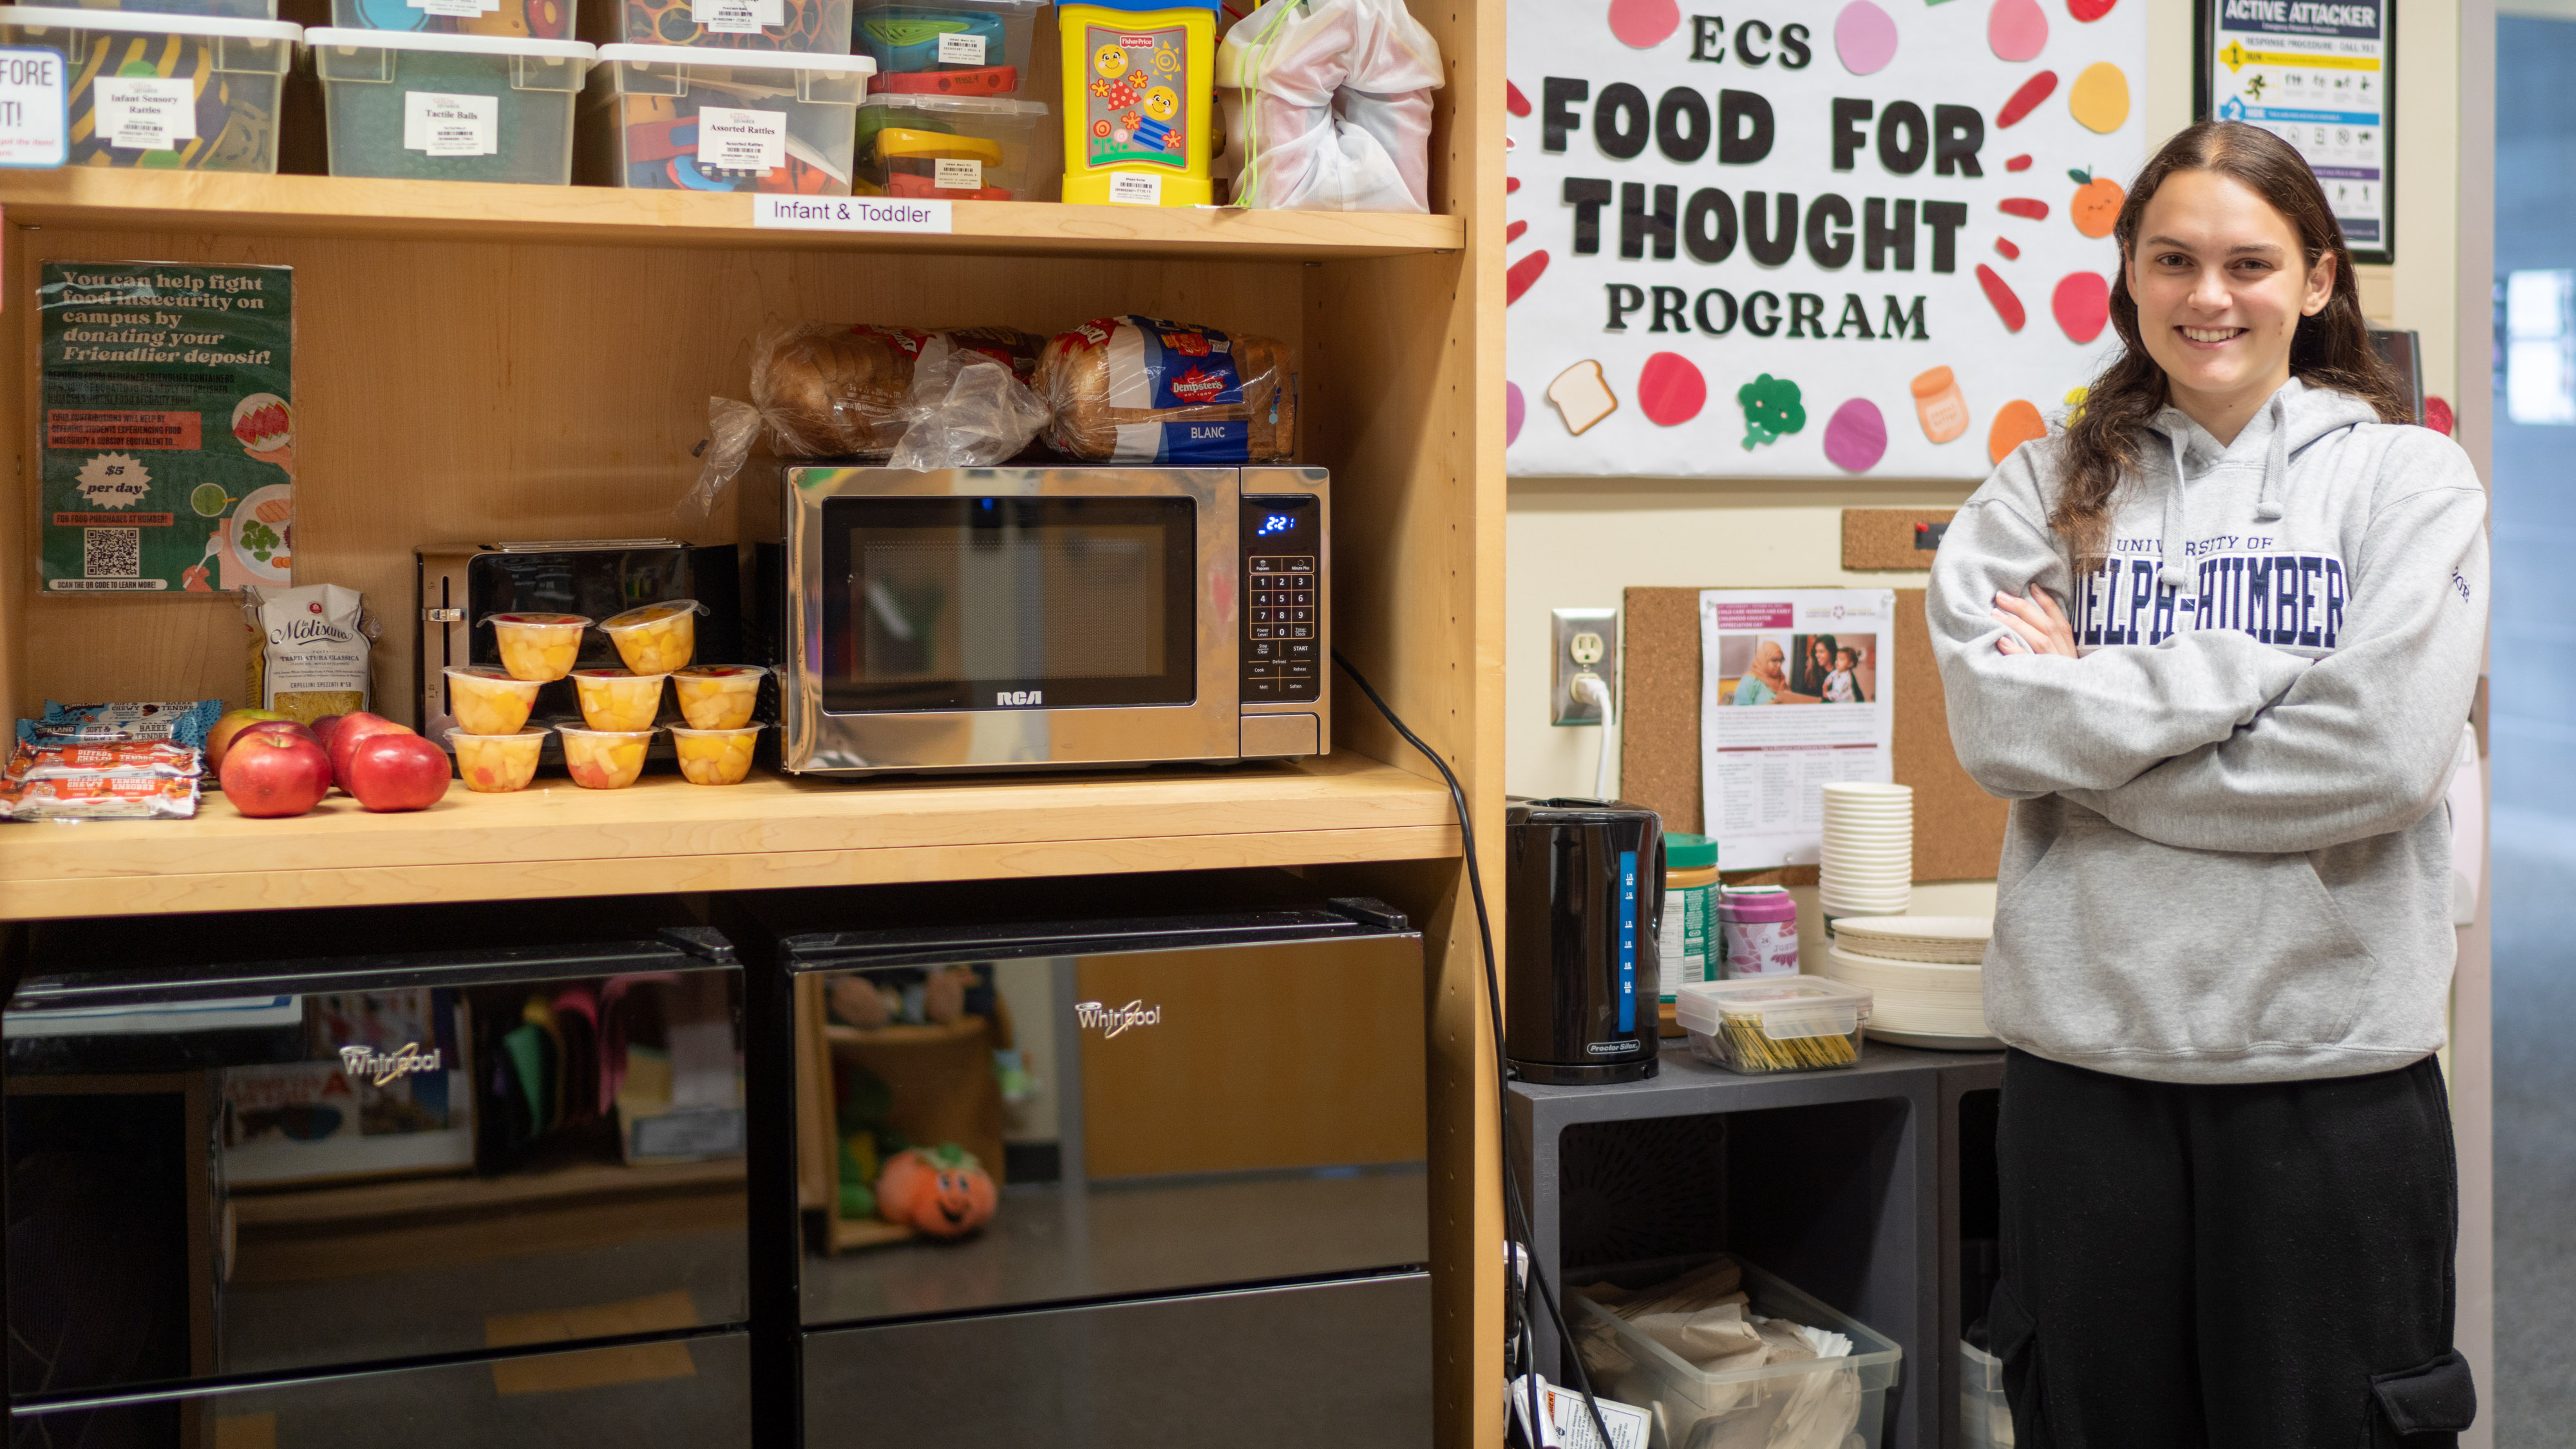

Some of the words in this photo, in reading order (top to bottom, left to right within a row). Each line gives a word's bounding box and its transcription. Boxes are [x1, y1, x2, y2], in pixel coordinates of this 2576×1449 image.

[2226, 0, 2287, 21] ACTIVE
[2289, 3, 2376, 27] ATTACKER
[1690, 14, 1812, 69] ECS
[2246, 37, 2285, 47] RESPONSE
[2288, 39, 2331, 50] PROCEDURE
[2340, 41, 2358, 52] CALL
[2231, 47, 2238, 64] 1
[2246, 52, 2262, 61] RUN
[142, 95, 178, 104] Sensory
[0, 101, 22, 127] T!
[425, 109, 455, 118] Tactile
[457, 111, 477, 120] Balls
[2229, 102, 2242, 120] 2
[710, 124, 745, 133] Assorted
[748, 126, 775, 135] Rattles
[1542, 75, 1776, 165] FOOD
[1832, 97, 1985, 178] FOR
[775, 201, 830, 220] Infant
[837, 204, 850, 220] &
[858, 204, 931, 223] Toddler
[1562, 176, 1967, 273] THOUGHT
[62, 271, 105, 287] You
[111, 277, 151, 289] can
[156, 274, 204, 292] help
[209, 275, 263, 294] fight
[62, 290, 110, 305] food
[117, 292, 232, 312] insecurity
[237, 297, 264, 309] on
[1604, 282, 1929, 341] PROGRAM
[62, 312, 151, 328] campus
[155, 311, 182, 329] by
[63, 327, 167, 346] donating
[168, 332, 225, 346] your
[62, 346, 180, 363] Friendlier
[184, 350, 271, 367] deposit!
[108, 372, 145, 382] RETURNED
[146, 372, 189, 383] FRIENDLIER
[190, 374, 234, 384] CONTAINERS
[1173, 380, 1223, 393] Dempster's
[136, 395, 169, 404] SECURITY
[171, 395, 191, 404] FUND
[71, 413, 121, 422] CONTRIBUTIONS
[123, 415, 138, 423] WILL
[140, 415, 155, 423] HELP
[85, 425, 116, 434] STUDENTS
[118, 426, 164, 435] EXPERIENCING
[165, 426, 181, 435] FOOD
[1191, 426, 1225, 439] BLANC
[52, 436, 89, 445] INSECURITY
[126, 437, 164, 446] EQUIVALENT
[105, 464, 125, 477] $5
[86, 483, 114, 496] per
[115, 482, 142, 496] day
[57, 515, 70, 523] FOR
[71, 515, 89, 524] FOOD
[90, 515, 128, 524] PURCHASES
[129, 515, 137, 524] AT
[138, 515, 167, 524] HUMBER!
[1266, 516, 1294, 530] 2:21
[2117, 536, 2239, 556] UNIVRSITY
[2247, 536, 2273, 549] OF
[57, 581, 73, 590] SCAN
[74, 581, 84, 589] THE
[85, 581, 94, 590] QR
[95, 581, 109, 590] CODE
[110, 581, 118, 589] TO
[118, 581, 137, 590] LEARN
[137, 581, 156, 590] MORE!
[270, 619, 353, 644] Molisana
[997, 690, 1042, 706] RCA
[35, 726, 75, 736] KIRKLAND
[1078, 1003, 1160, 1032] Whirlpool
[341, 1047, 442, 1079] Whirlpool
